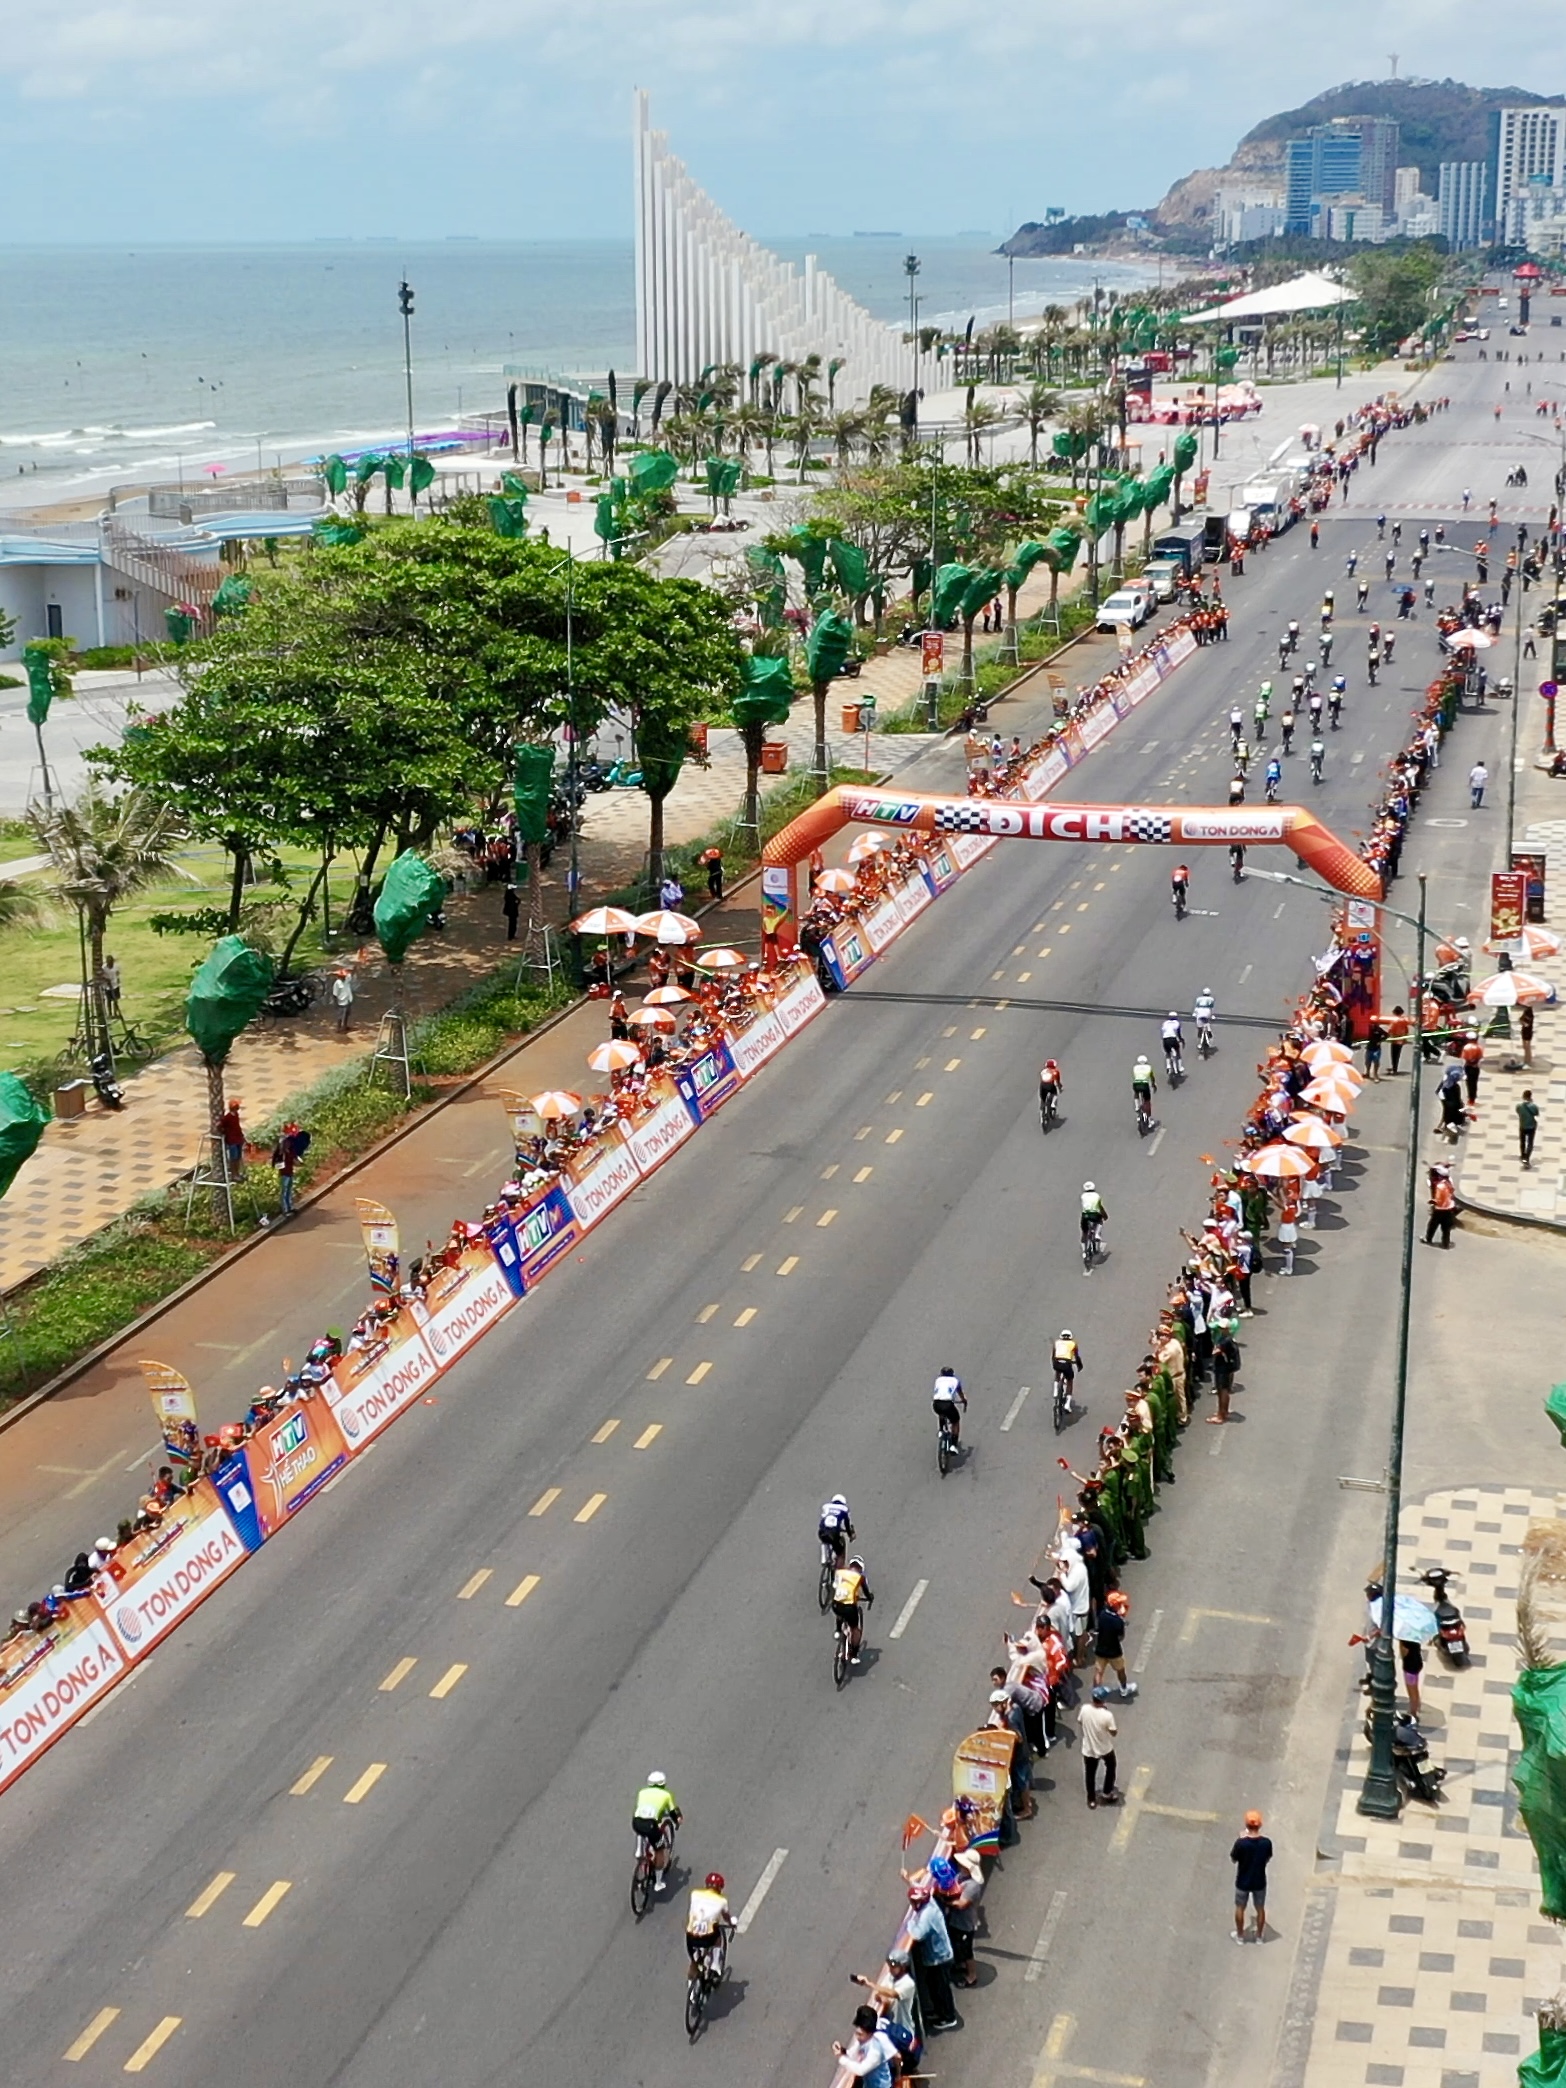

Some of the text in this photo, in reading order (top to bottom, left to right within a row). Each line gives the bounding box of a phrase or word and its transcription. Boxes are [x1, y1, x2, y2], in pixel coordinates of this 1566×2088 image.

[857, 802, 916, 821] HTV
[1199, 825, 1280, 837] TON DONG A
[643, 1109, 690, 1154] TON DONG A
[585, 1188, 606, 1211] TON
[602, 1166, 629, 1194] DONG
[624, 1158, 635, 1174] A
[517, 1210, 548, 1256] HTV
[443, 1312, 469, 1346] TON
[464, 1291, 499, 1327] DONG
[494, 1279, 508, 1297] A
[356, 1387, 388, 1426] TON
[383, 1360, 421, 1403] DONG
[417, 1352, 432, 1373] A
[270, 1415, 306, 1461] HTV
[291, 1446, 317, 1477] THAO
[138, 1581, 180, 1627] TON
[174, 1540, 224, 1597] DONG
[220, 1530, 238, 1556] A
[1, 1703, 48, 1755] TON
[41, 1655, 100, 1719] DONG
[97, 1643, 116, 1672] A
